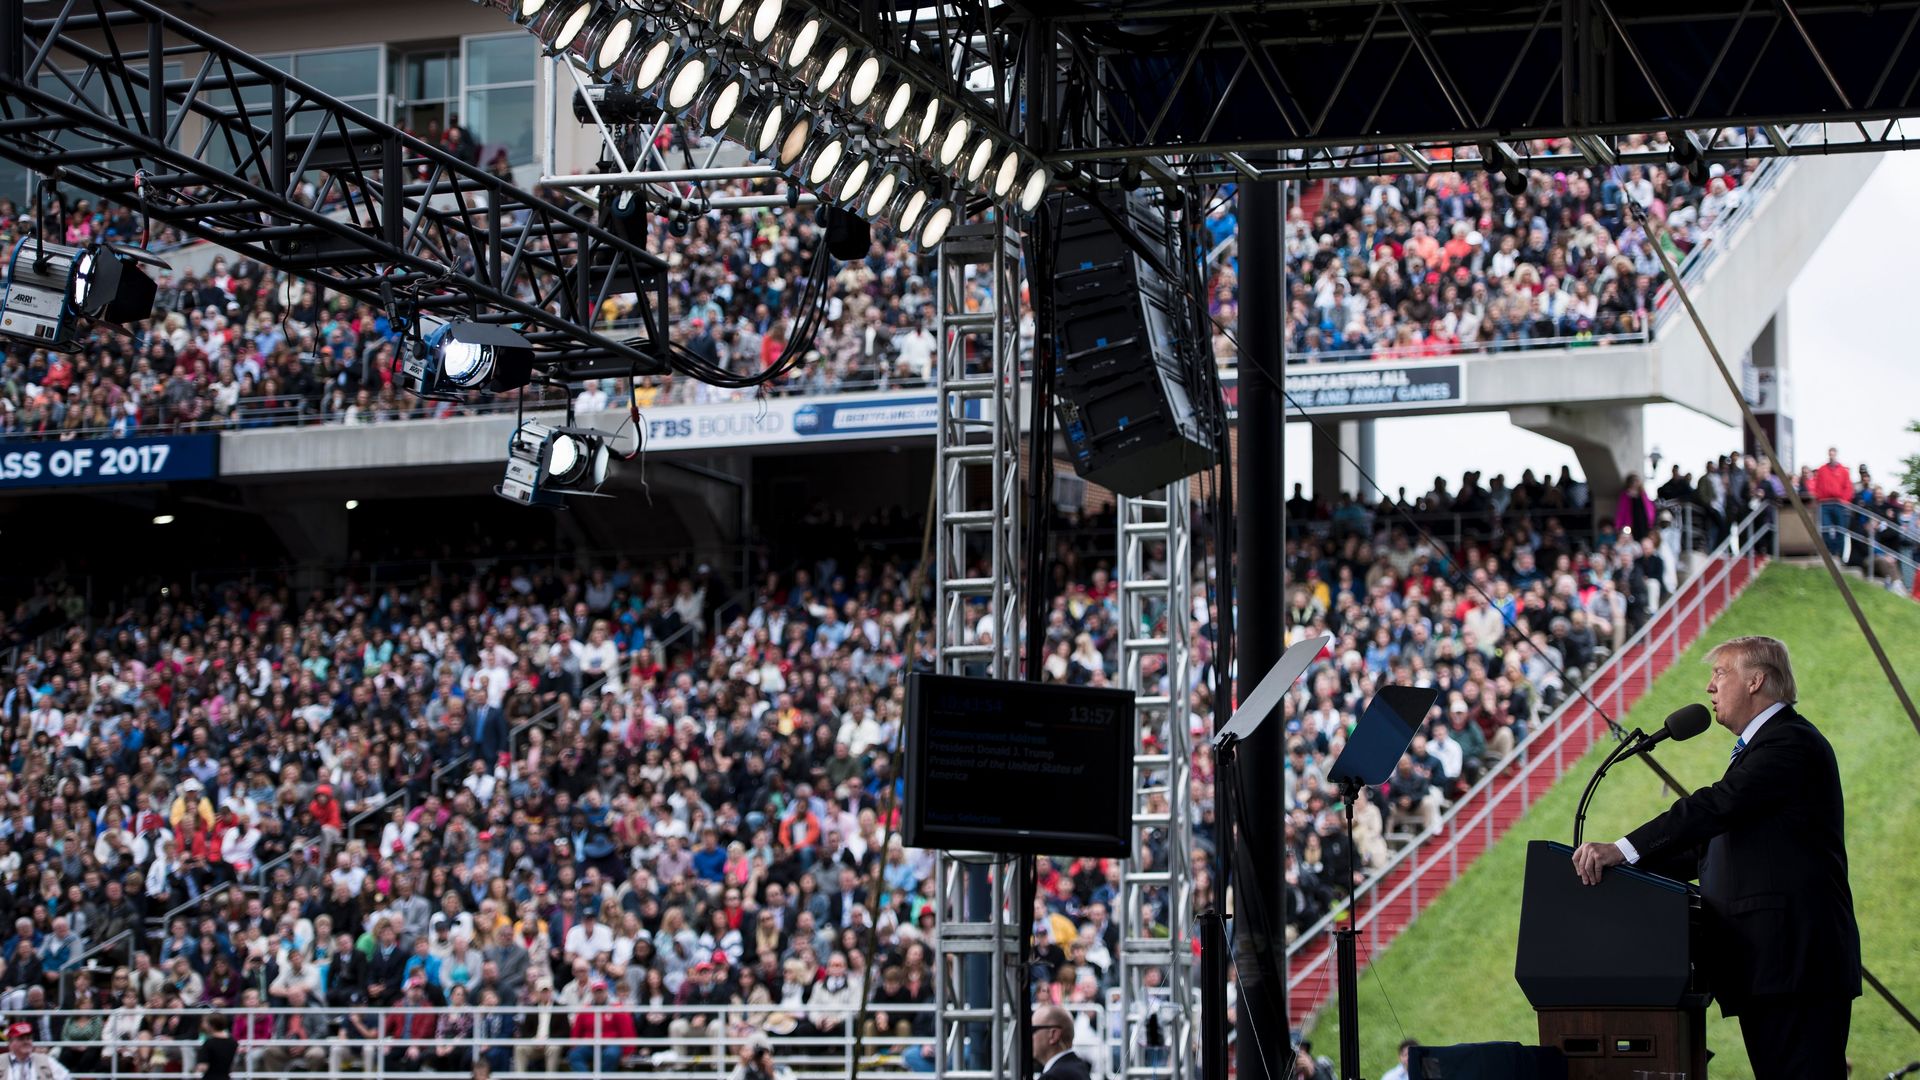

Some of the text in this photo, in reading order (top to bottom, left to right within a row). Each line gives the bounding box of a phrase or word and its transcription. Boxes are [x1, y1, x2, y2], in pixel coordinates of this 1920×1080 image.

[14, 293, 32, 304] ARRI
[1316, 388, 1350, 406] AND
[1350, 386, 1396, 403] AWAY
[1396, 383, 1450, 400] GAMES
[650, 418, 692, 438] FBS
[699, 411, 784, 437] BOUND
[0, 445, 170, 479] SS OF 2017
[1069, 705, 1115, 725] 13:57
[929, 742, 1055, 761] President Donald J. Trump
[929, 756, 1085, 775] President of the United States of
[929, 769, 969, 781] America
